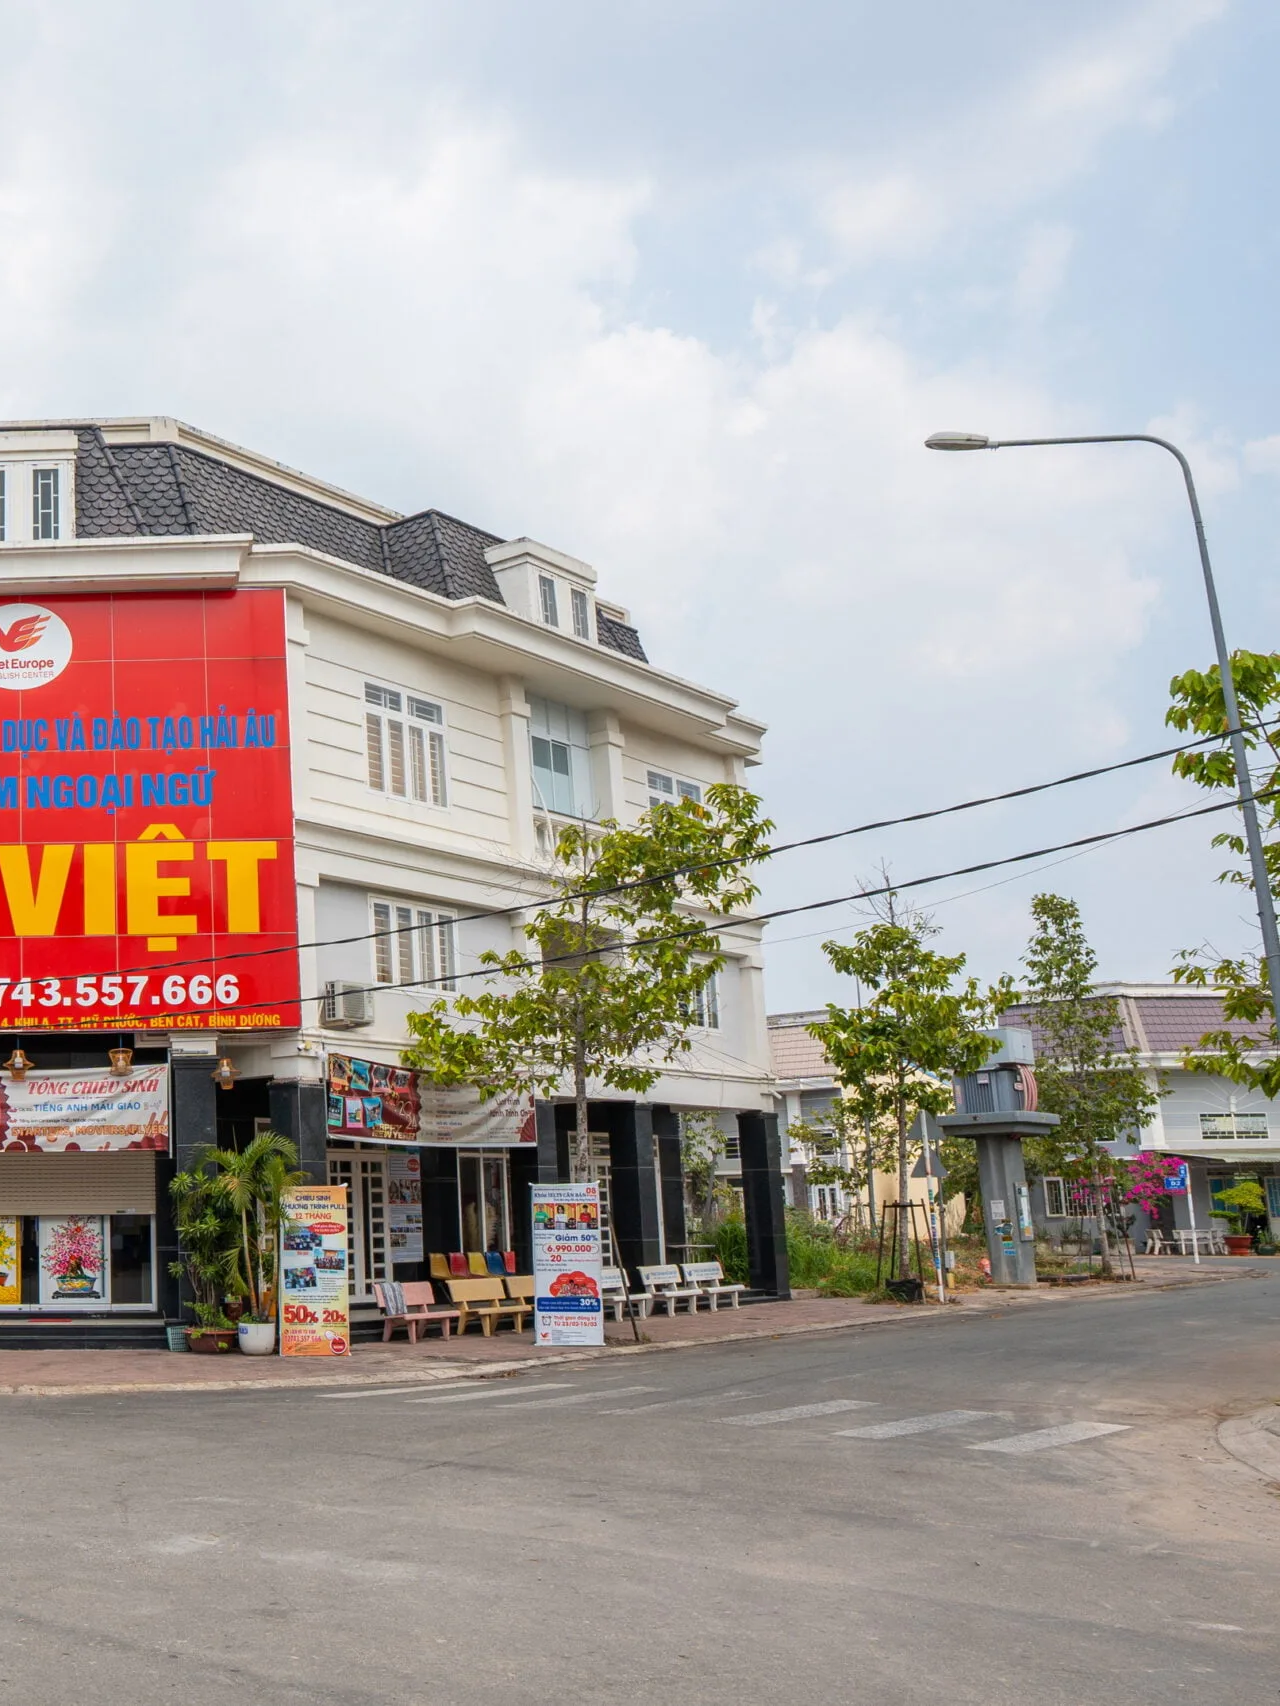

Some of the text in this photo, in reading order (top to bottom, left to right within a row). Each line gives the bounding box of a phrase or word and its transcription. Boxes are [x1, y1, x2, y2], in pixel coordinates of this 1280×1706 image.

[21, 671, 54, 679] CENTER
[2, 718, 48, 758] DỤC
[54, 711, 86, 751] VÀ
[92, 710, 141, 751] ĐÀO
[147, 715, 194, 755] TẠO
[199, 704, 237, 748] HẢI
[244, 707, 276, 748] ÂU
[26, 773, 134, 815] NGOẠI
[140, 766, 217, 807] NGỮ
[209, 1013, 236, 1027] BÌNH
[240, 1013, 281, 1027] DƯƠNG
[121, 1079, 160, 1094] SINH
[33, 1100, 63, 1112] TIẾNG
[66, 1103, 88, 1112] ANH
[305, 1211, 331, 1219] THÁNG
[555, 1233, 578, 1242] Giảm
[547, 1245, 592, 1253] 6.990.000
[580, 1298, 598, 1306] 30%
[284, 1304, 347, 1323] 50% 20%
